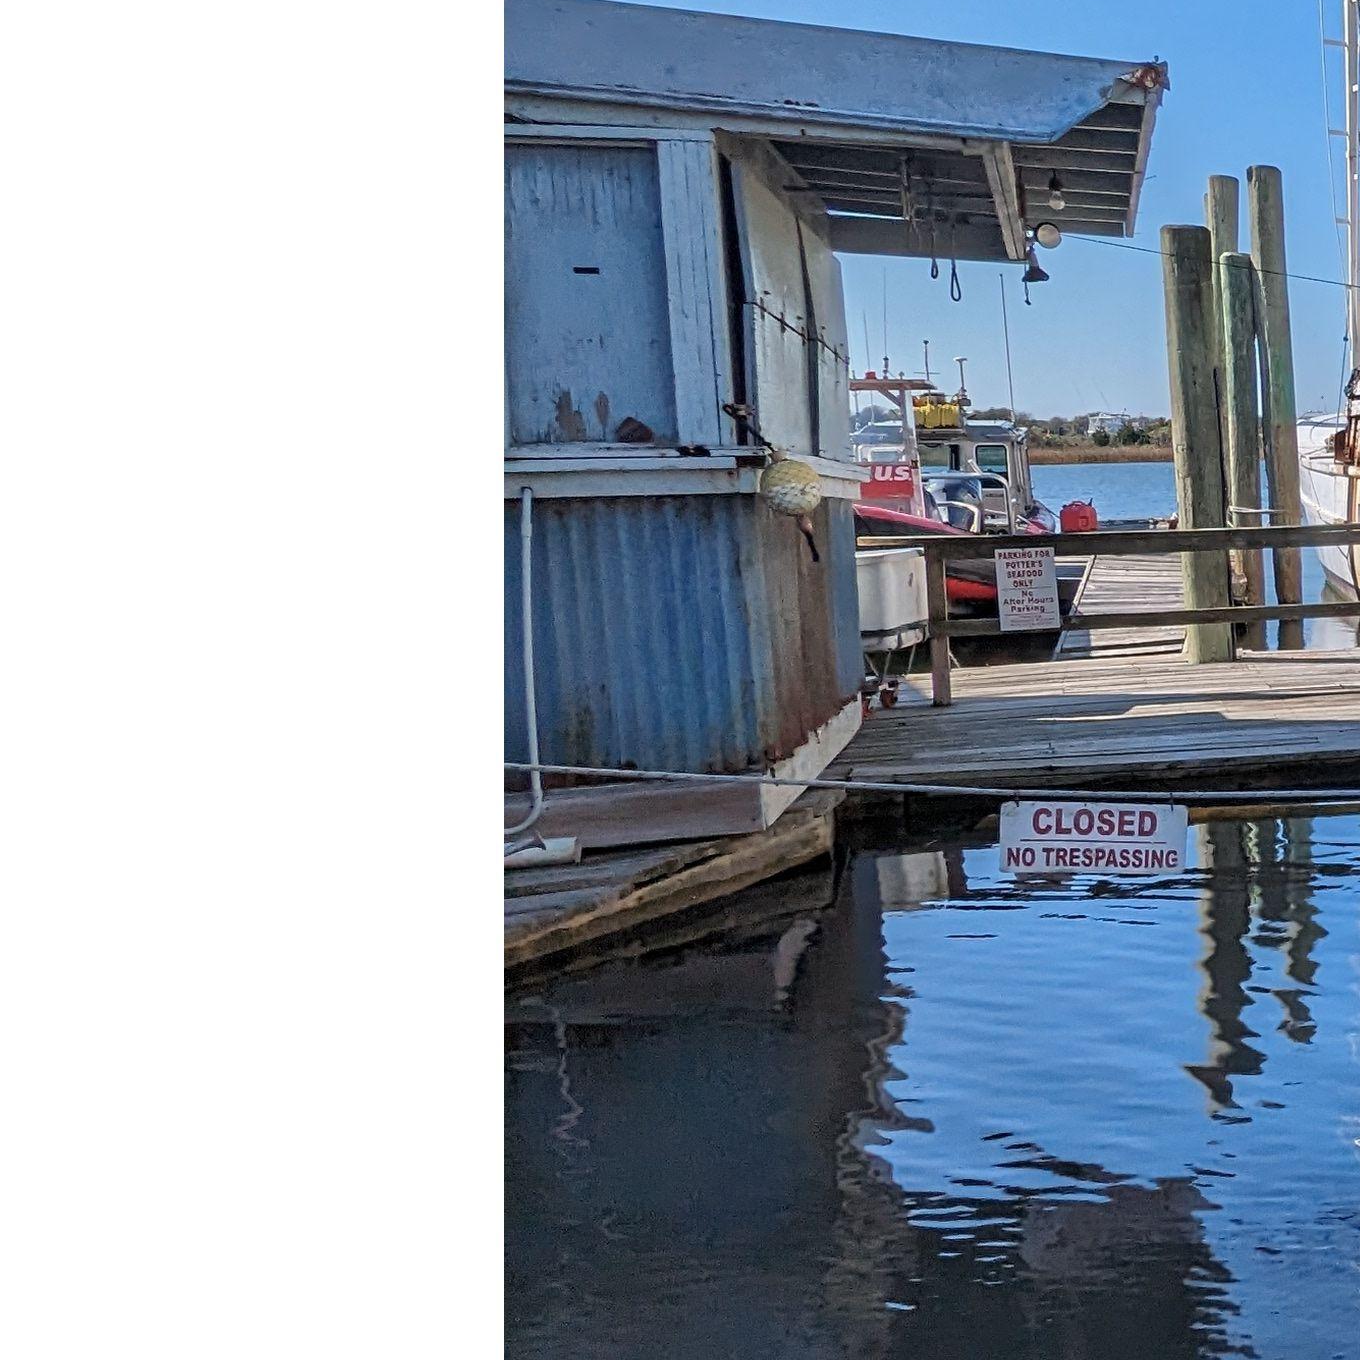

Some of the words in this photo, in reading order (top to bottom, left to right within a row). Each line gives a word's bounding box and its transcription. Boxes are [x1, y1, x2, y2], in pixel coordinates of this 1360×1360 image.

[998, 551, 1033, 560] PARKING
[1035, 550, 1051, 558] FOR
[1005, 560, 1043, 569] POTTER'S
[1007, 570, 1043, 579] SEAFOOD
[1013, 580, 1033, 588] ONLY
[1033, 807, 1157, 837] CLOSED
[1007, 847, 1036, 867] NO
[1041, 847, 1178, 869] TRESPASSING
